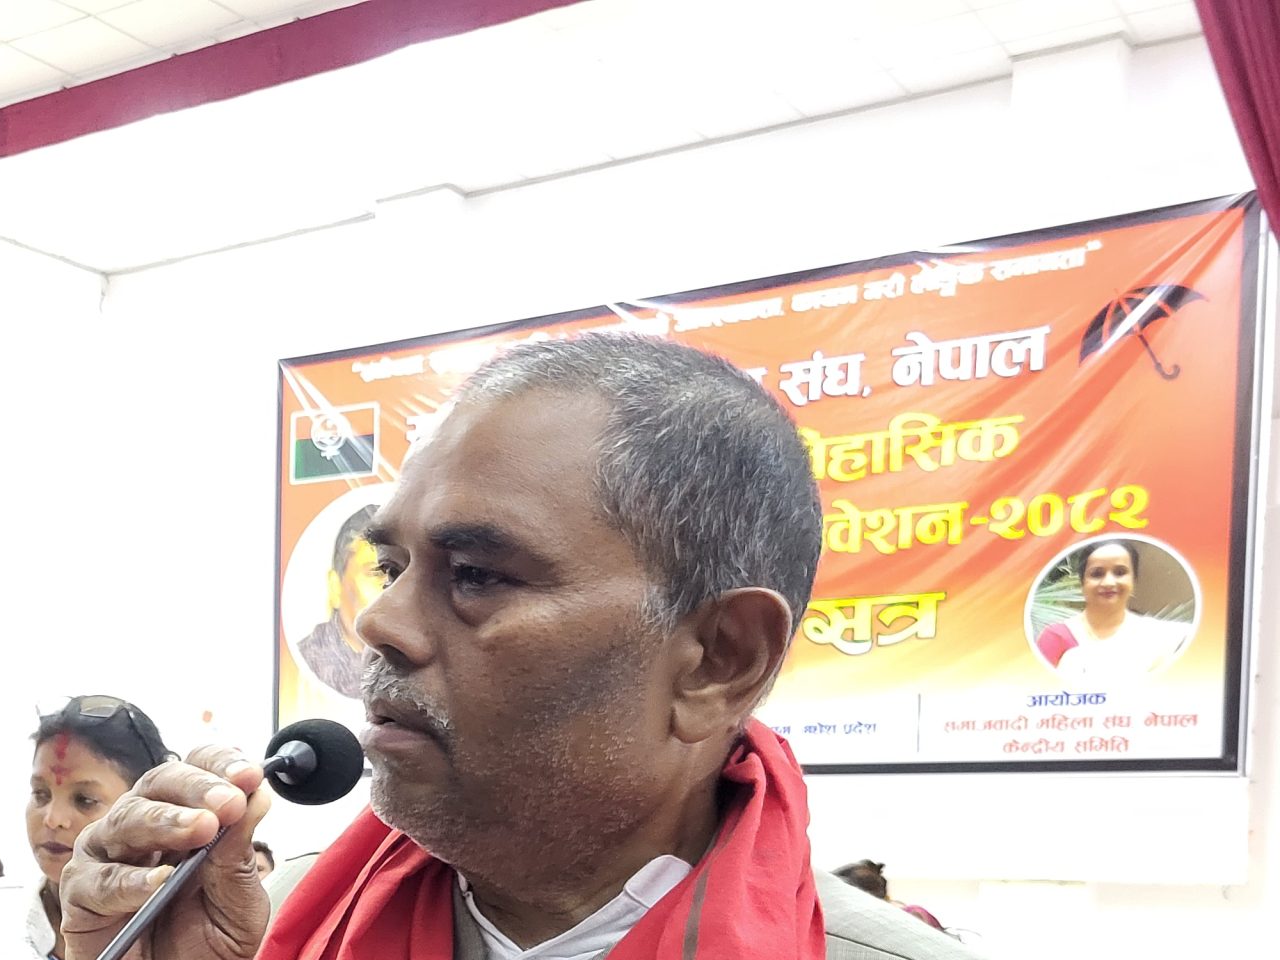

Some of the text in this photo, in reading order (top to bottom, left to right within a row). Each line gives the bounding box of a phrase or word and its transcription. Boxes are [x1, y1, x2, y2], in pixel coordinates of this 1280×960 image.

[779, 350, 871, 407] संघ,
[891, 326, 1051, 387] नेपाल
[821, 484, 1150, 555] वेशन-२०८२
[1026, 690, 1107, 708] आयोजक
[1036, 713, 1094, 731] महिला
[1143, 711, 1199, 729] नेपाल
[1073, 735, 1131, 754] समिति
